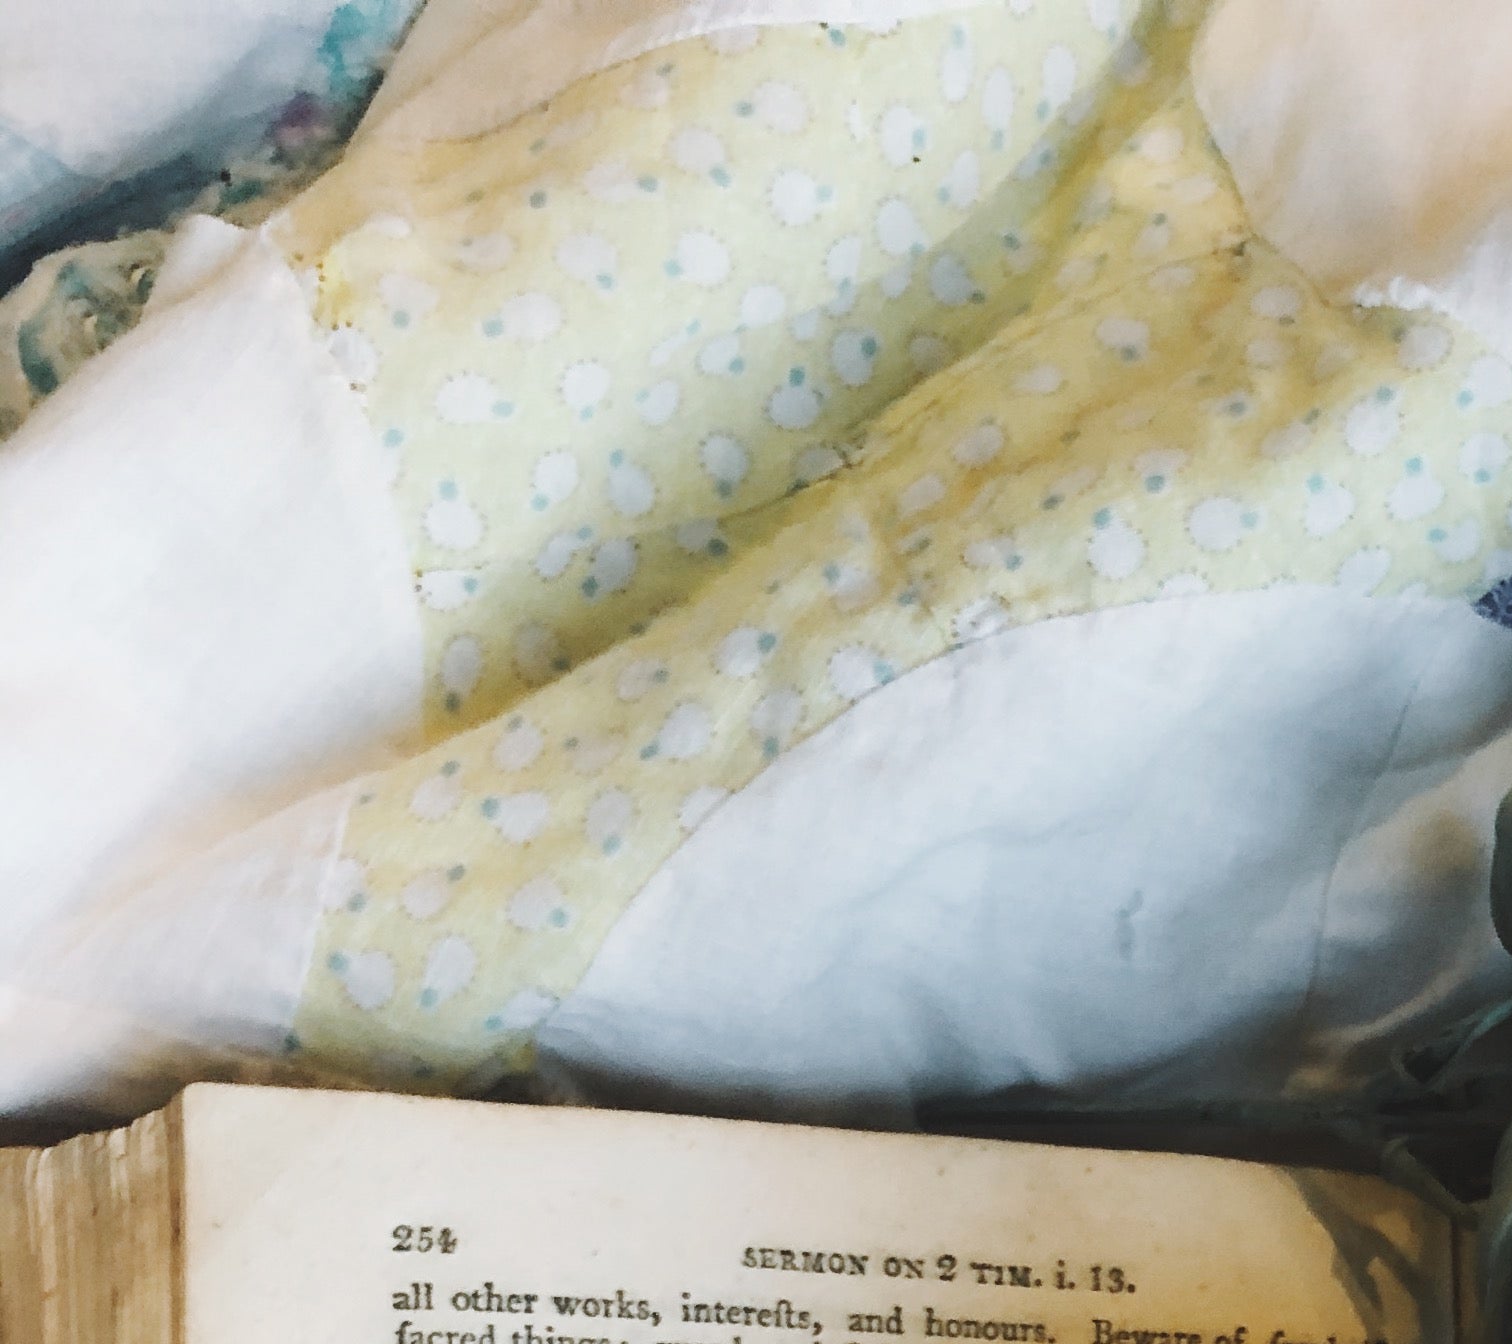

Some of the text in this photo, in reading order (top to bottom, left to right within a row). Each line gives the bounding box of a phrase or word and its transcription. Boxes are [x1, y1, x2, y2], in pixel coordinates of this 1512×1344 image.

[740, 1246, 870, 1276] SERMON
[882, 1255, 926, 1280] ON
[935, 1253, 958, 1283] 2
[391, 1282, 434, 1311] all
[449, 1281, 539, 1314] other
[550, 1289, 663, 1327] works,
[847, 1305, 906, 1336] and
[924, 1306, 1057, 1344] honours.
